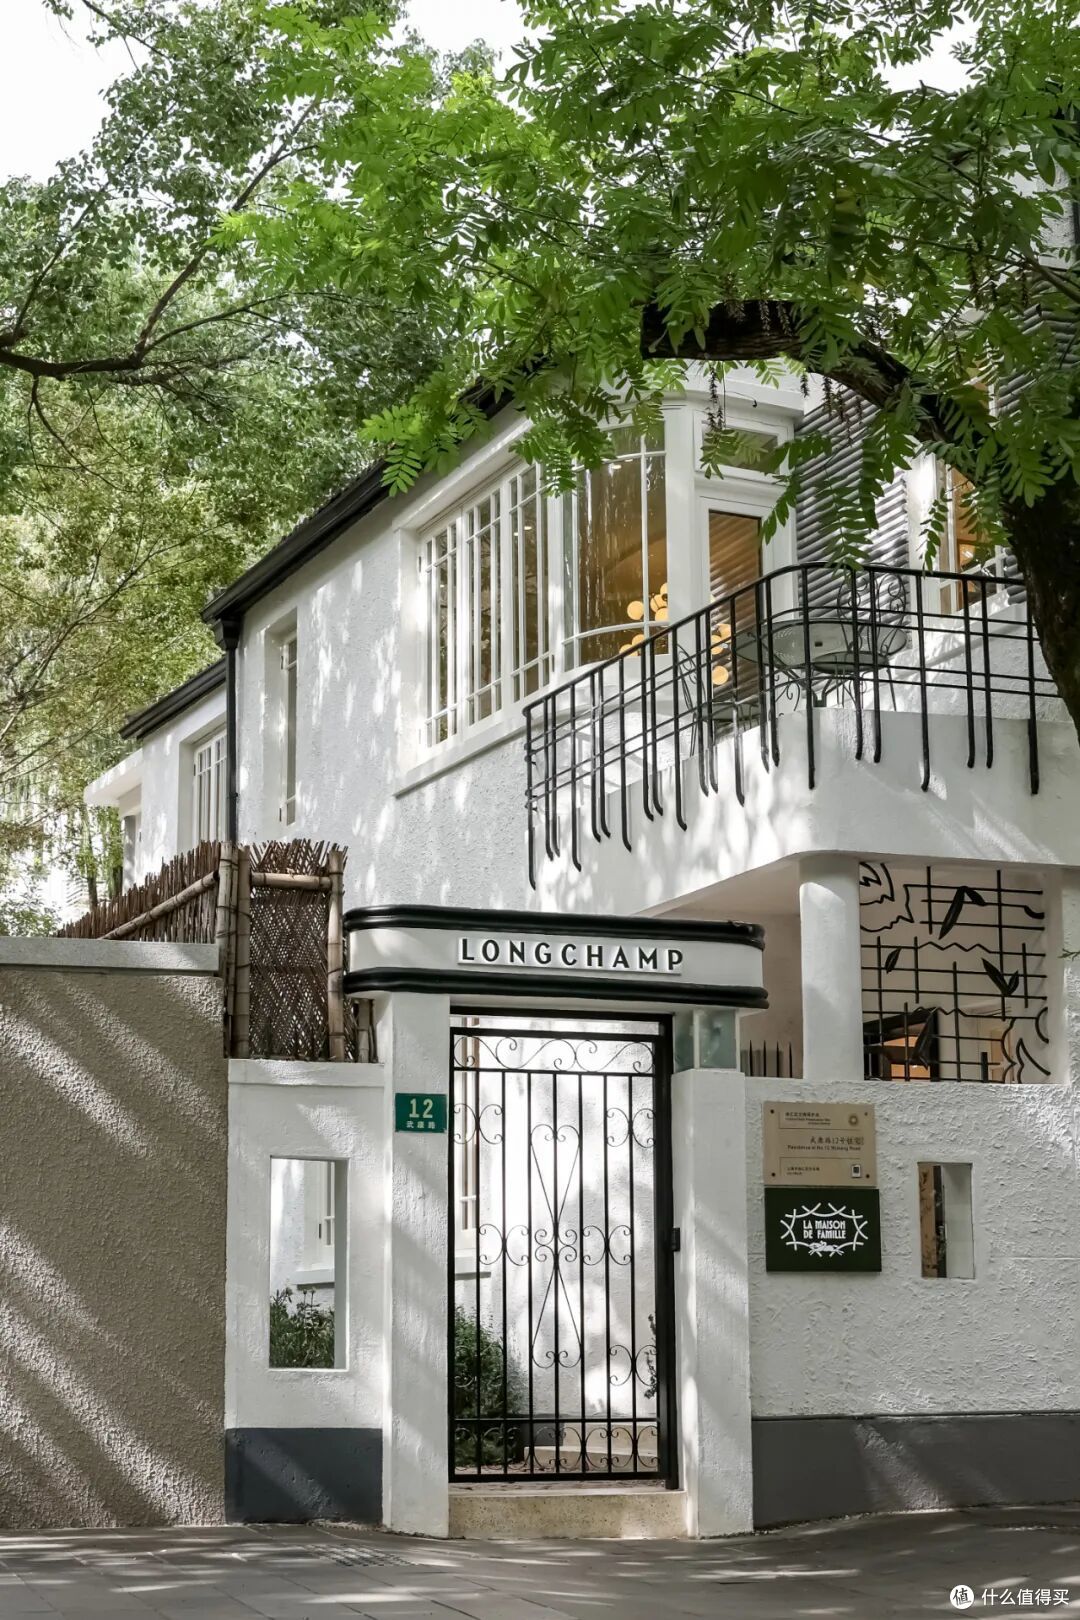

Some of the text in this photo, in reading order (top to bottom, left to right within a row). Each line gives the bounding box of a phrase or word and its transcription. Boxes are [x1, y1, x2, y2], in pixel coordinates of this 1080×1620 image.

[462, 938, 683, 970] LONGCHAMP
[409, 1098, 433, 1118] 12
[406, 1120, 436, 1129] 武康路
[803, 1220, 846, 1230] LA MAISON
[803, 1230, 847, 1239] DE FAMILLE
